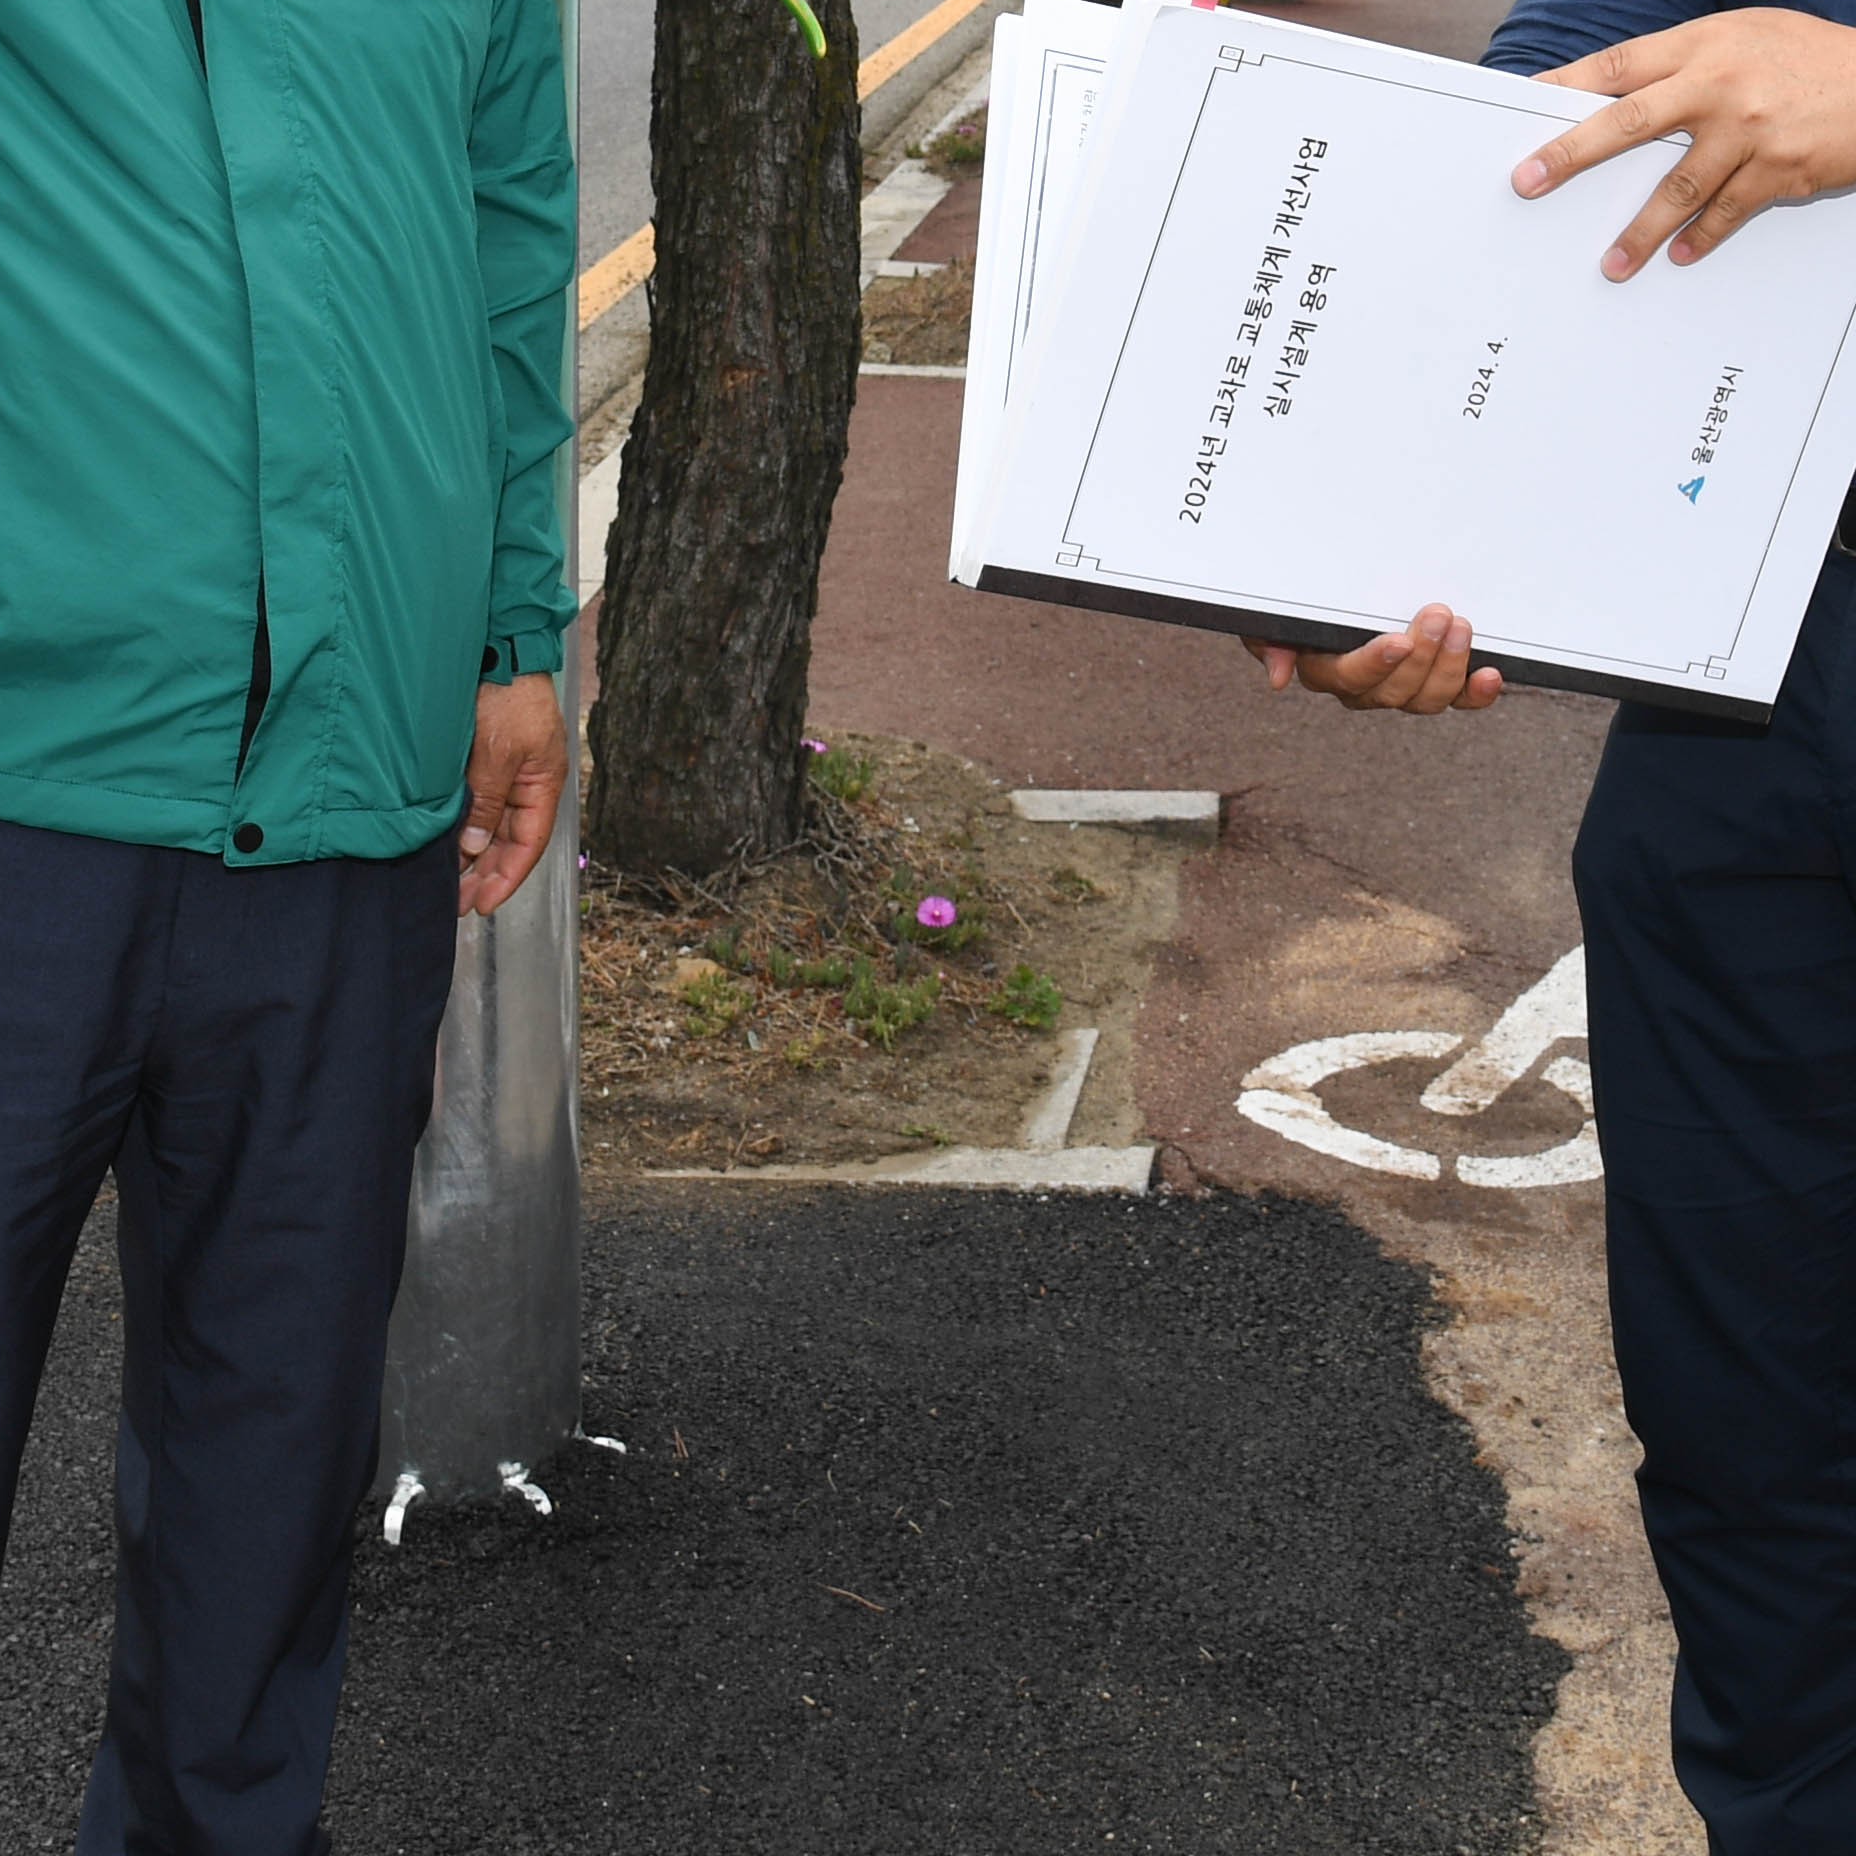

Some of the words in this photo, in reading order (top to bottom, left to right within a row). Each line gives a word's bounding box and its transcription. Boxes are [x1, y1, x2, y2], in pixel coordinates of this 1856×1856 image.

[1178, 435, 1228, 524] 2024년
[1209, 355, 1252, 429] 교차로
[1236, 245, 1292, 347] 교통체계
[1272, 137, 1328, 238] 개선사업
[1263, 319, 1318, 418] 실시설계
[1299, 263, 1337, 313] 용역
[1462, 362, 1499, 419] 2024.
[1487, 336, 1508, 355] 4.
[1691, 365, 1744, 465] 울산광역시
